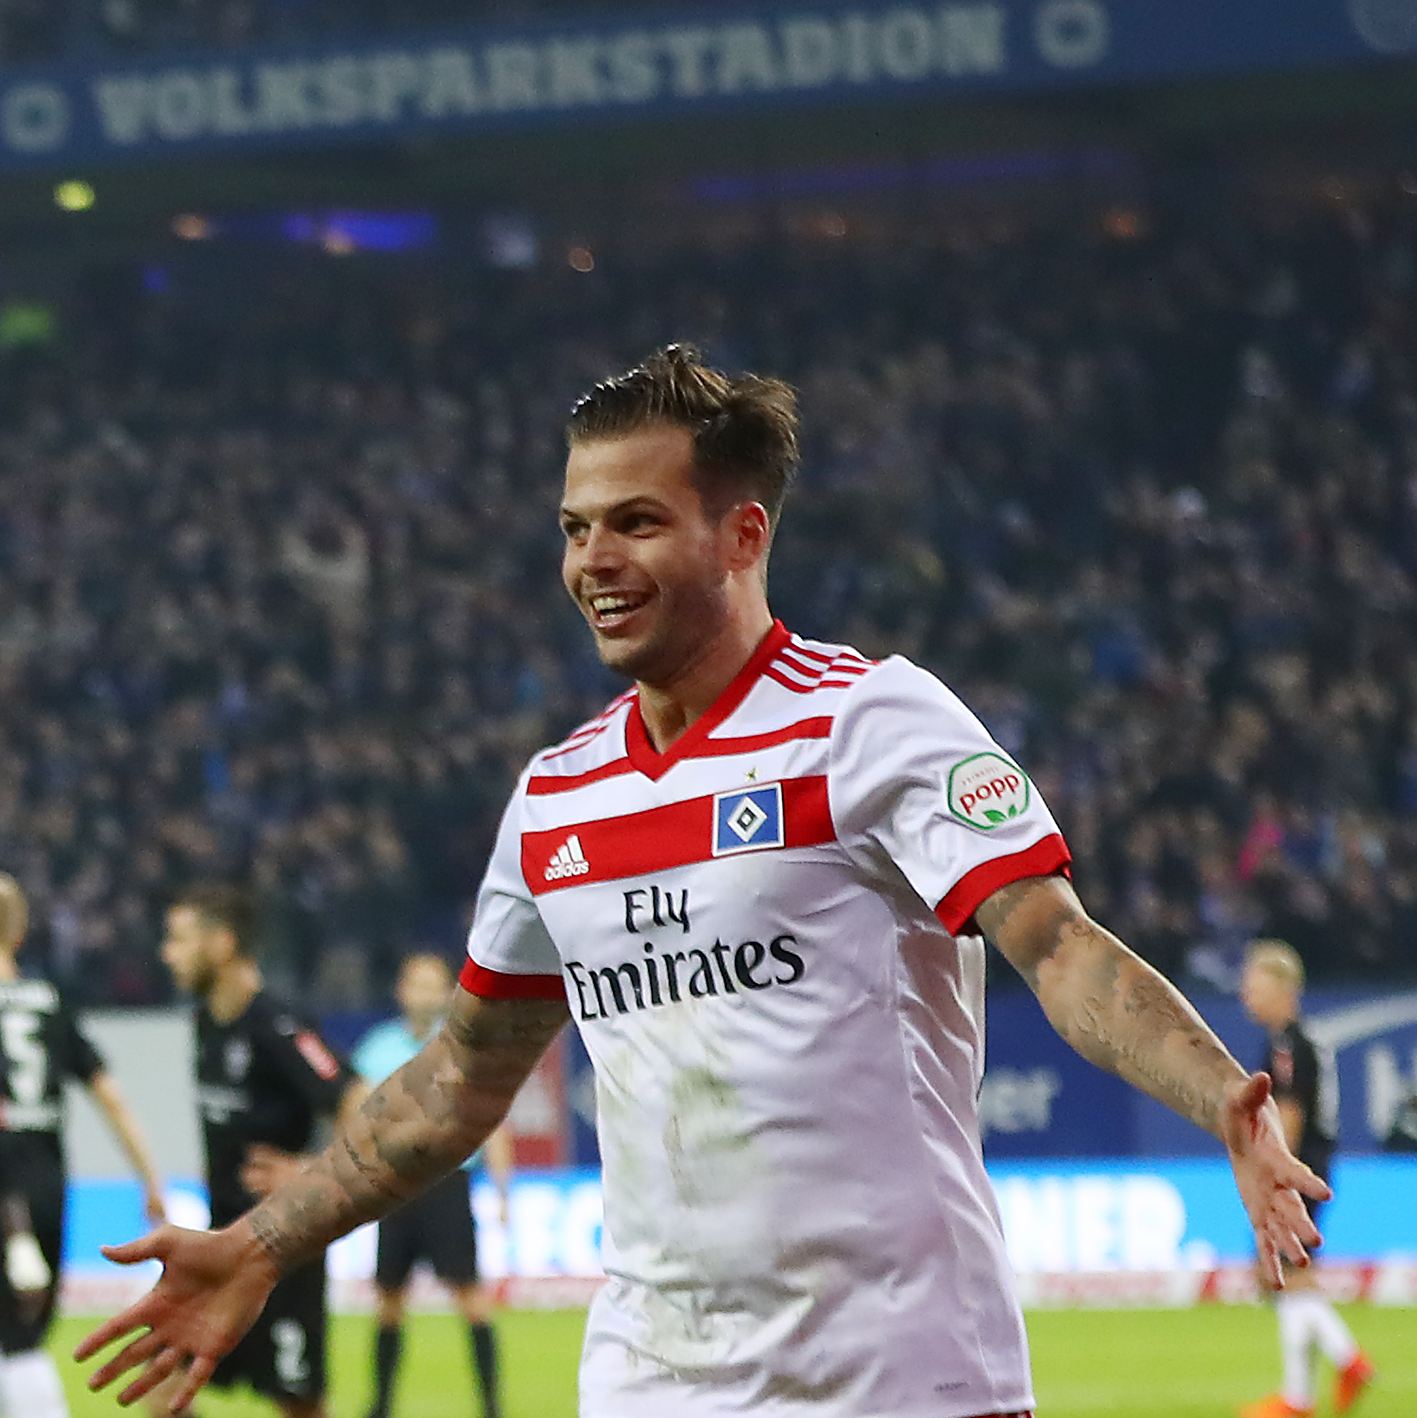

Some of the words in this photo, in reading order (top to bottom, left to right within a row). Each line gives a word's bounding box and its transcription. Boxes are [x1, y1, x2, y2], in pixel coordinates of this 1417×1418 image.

[93, 9, 1004, 146] VOLKSPARKSTADION
[959, 774, 1020, 817] popp
[544, 860, 590, 881] adidas
[623, 885, 690, 934] Fly
[565, 934, 805, 1021] Emirates
